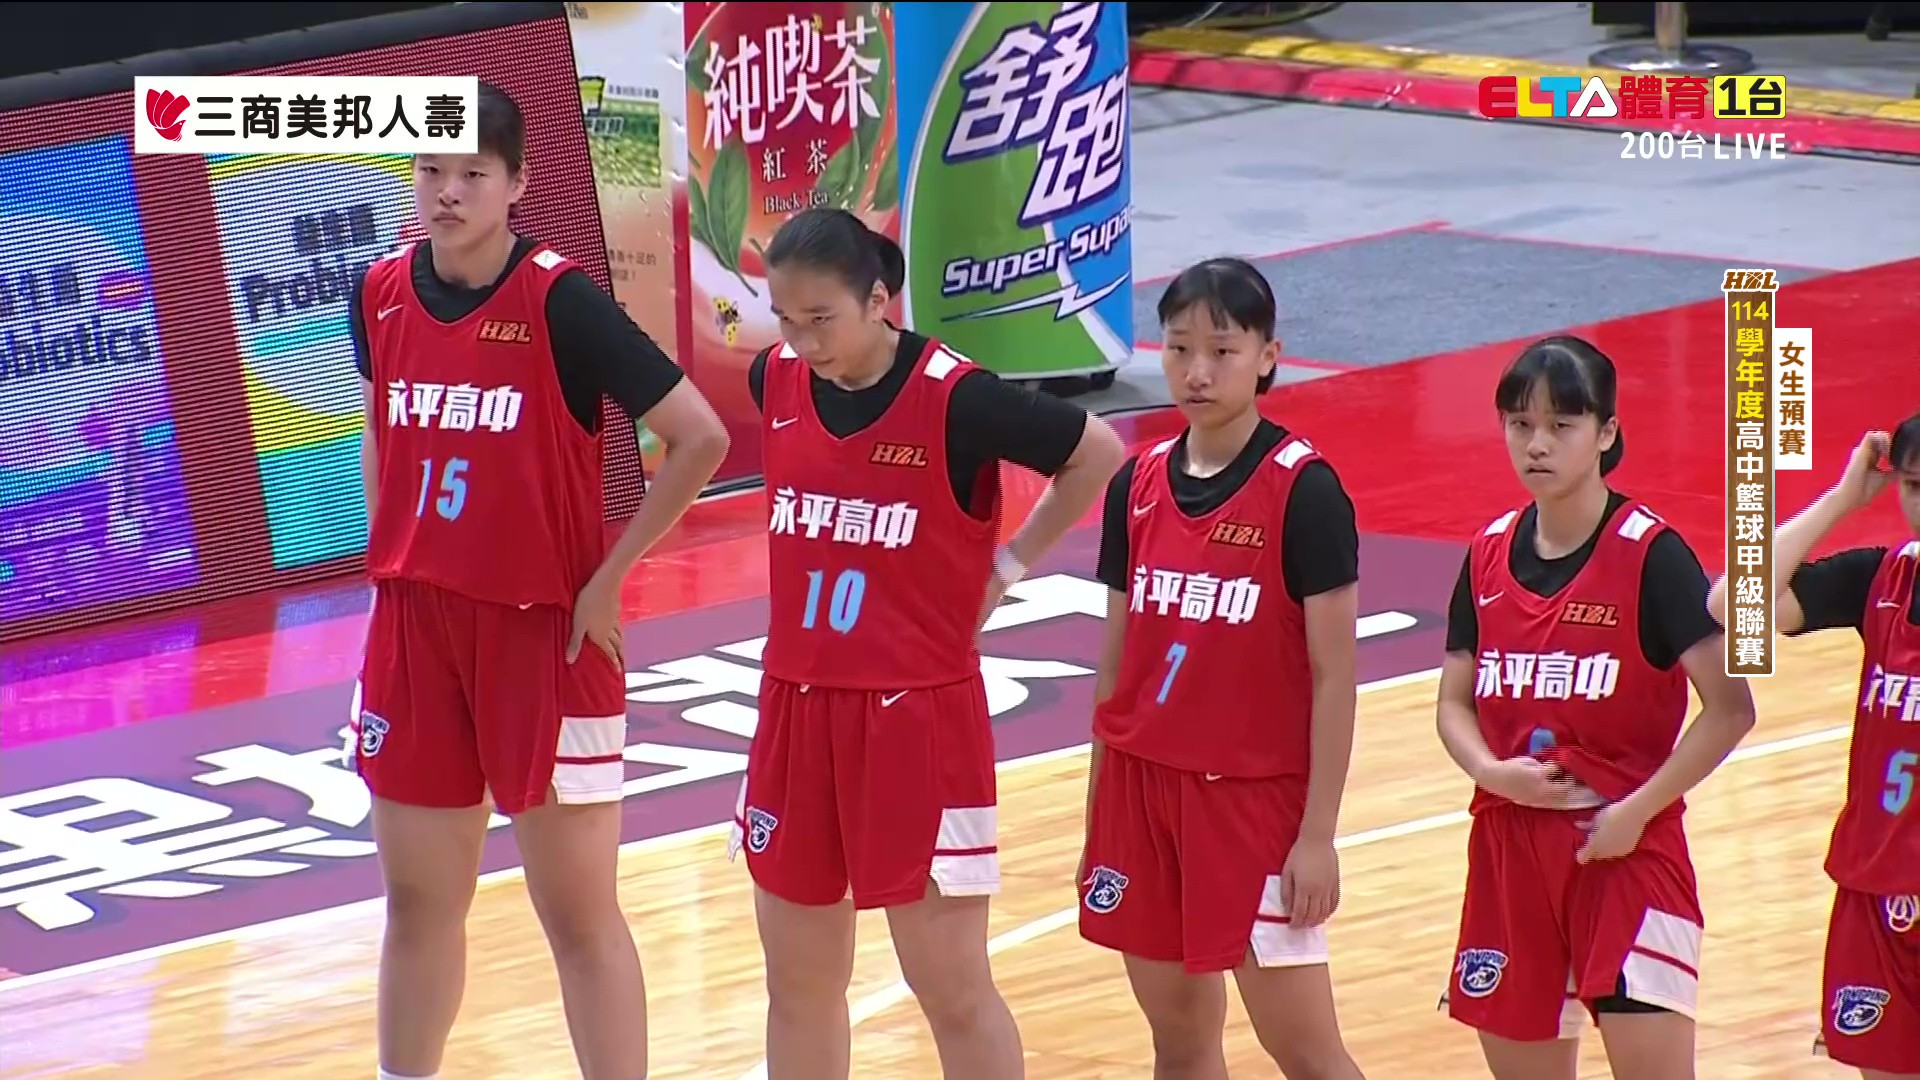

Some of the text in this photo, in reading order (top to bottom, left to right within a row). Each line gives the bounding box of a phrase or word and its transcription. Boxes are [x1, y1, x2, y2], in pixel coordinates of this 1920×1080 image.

[703, 13, 881, 149] 純喫茶
[946, 2, 1128, 220] 舒跑
[762, 138, 828, 182] 紅茶
[764, 188, 829, 214] Black Tea
[943, 241, 1064, 295] Super
[0, 314, 151, 380] biotics
[478, 320, 532, 343] HBL
[388, 379, 523, 432] 永平高中
[870, 443, 927, 467] HBL
[416, 457, 469, 521] 15
[769, 486, 918, 549] 永平高中
[1211, 521, 1265, 549] HBL
[801, 569, 865, 635] 10
[1129, 564, 1260, 625] 永平高中
[1561, 602, 1619, 627] HBL
[1155, 642, 1186, 705] 7
[1475, 648, 1620, 700] 永平高中
[1882, 749, 1919, 815] 5
